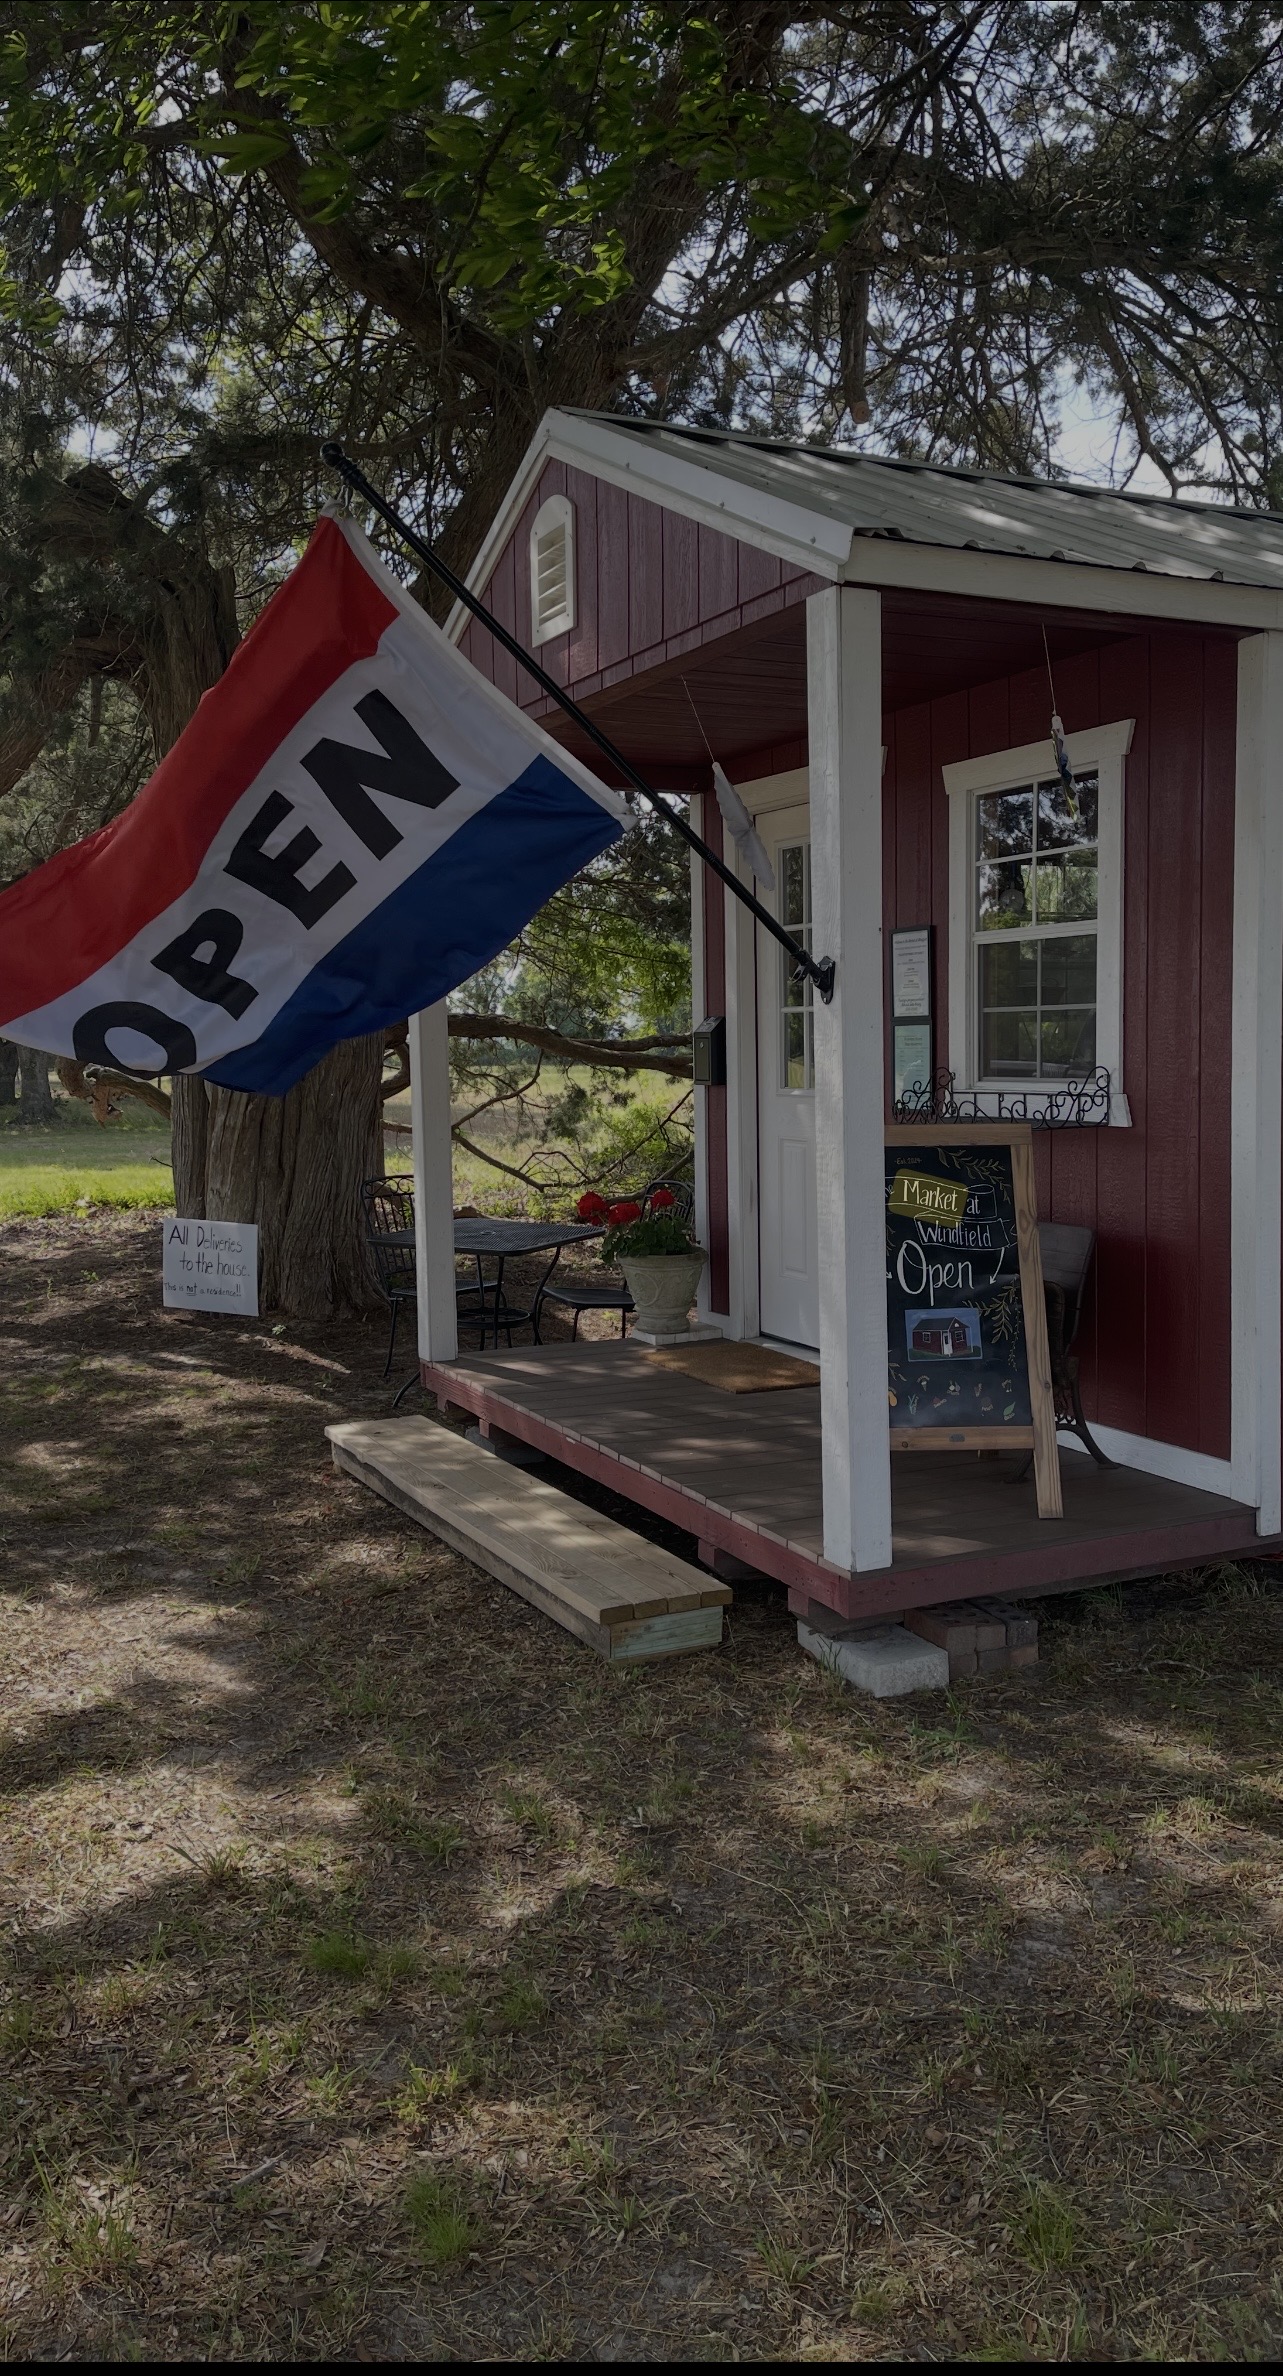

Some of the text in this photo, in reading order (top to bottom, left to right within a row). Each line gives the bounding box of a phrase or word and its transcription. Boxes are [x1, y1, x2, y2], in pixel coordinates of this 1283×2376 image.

[73, 689, 461, 1080] OPEN
[903, 1179, 958, 1212] Market
[966, 1195, 981, 1215] at
[168, 1225, 243, 1253] All Deliveries
[917, 1220, 992, 1247] Windfield
[179, 1251, 250, 1277] to the house.
[897, 1239, 975, 1306] Open
[164, 1282, 177, 1291] This
[186, 1282, 197, 1294] not
[206, 1283, 242, 1297] residence!!
